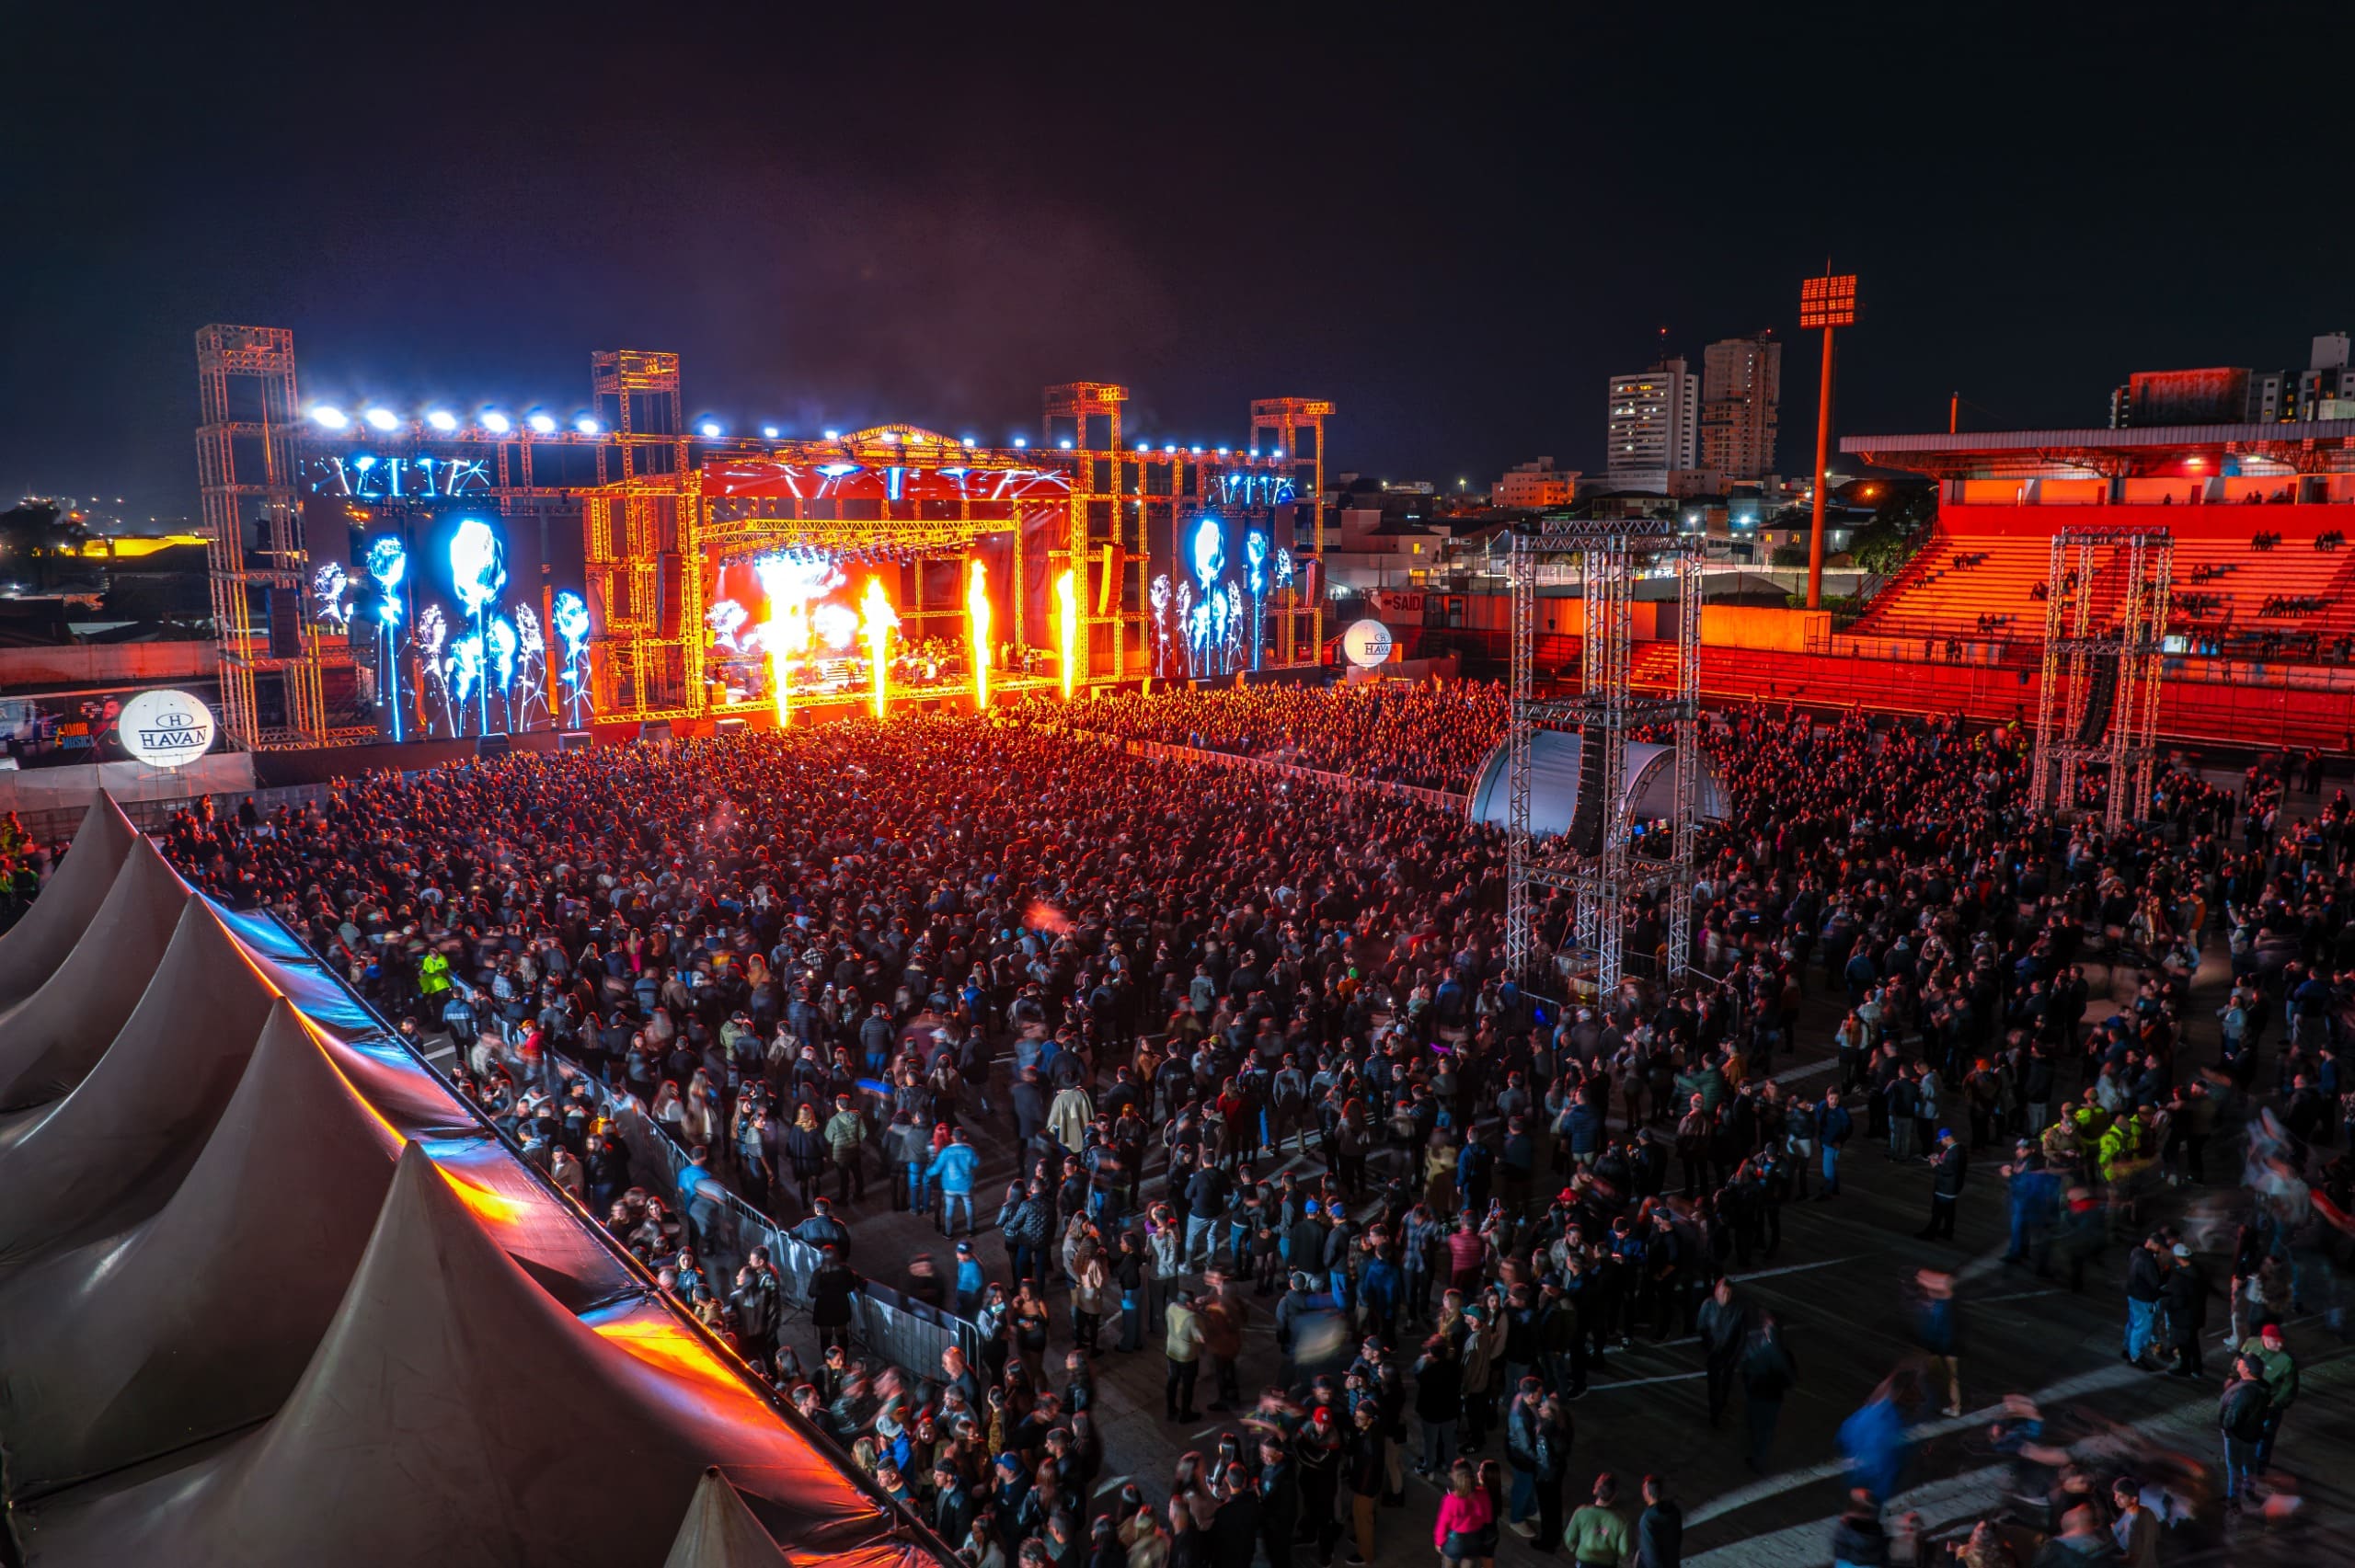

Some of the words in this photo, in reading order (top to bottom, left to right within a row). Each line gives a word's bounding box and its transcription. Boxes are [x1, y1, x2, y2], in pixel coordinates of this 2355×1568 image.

[1365, 646, 1389, 654] HAVA
[170, 715, 181, 726] H
[141, 729, 207, 746] HAVAN
